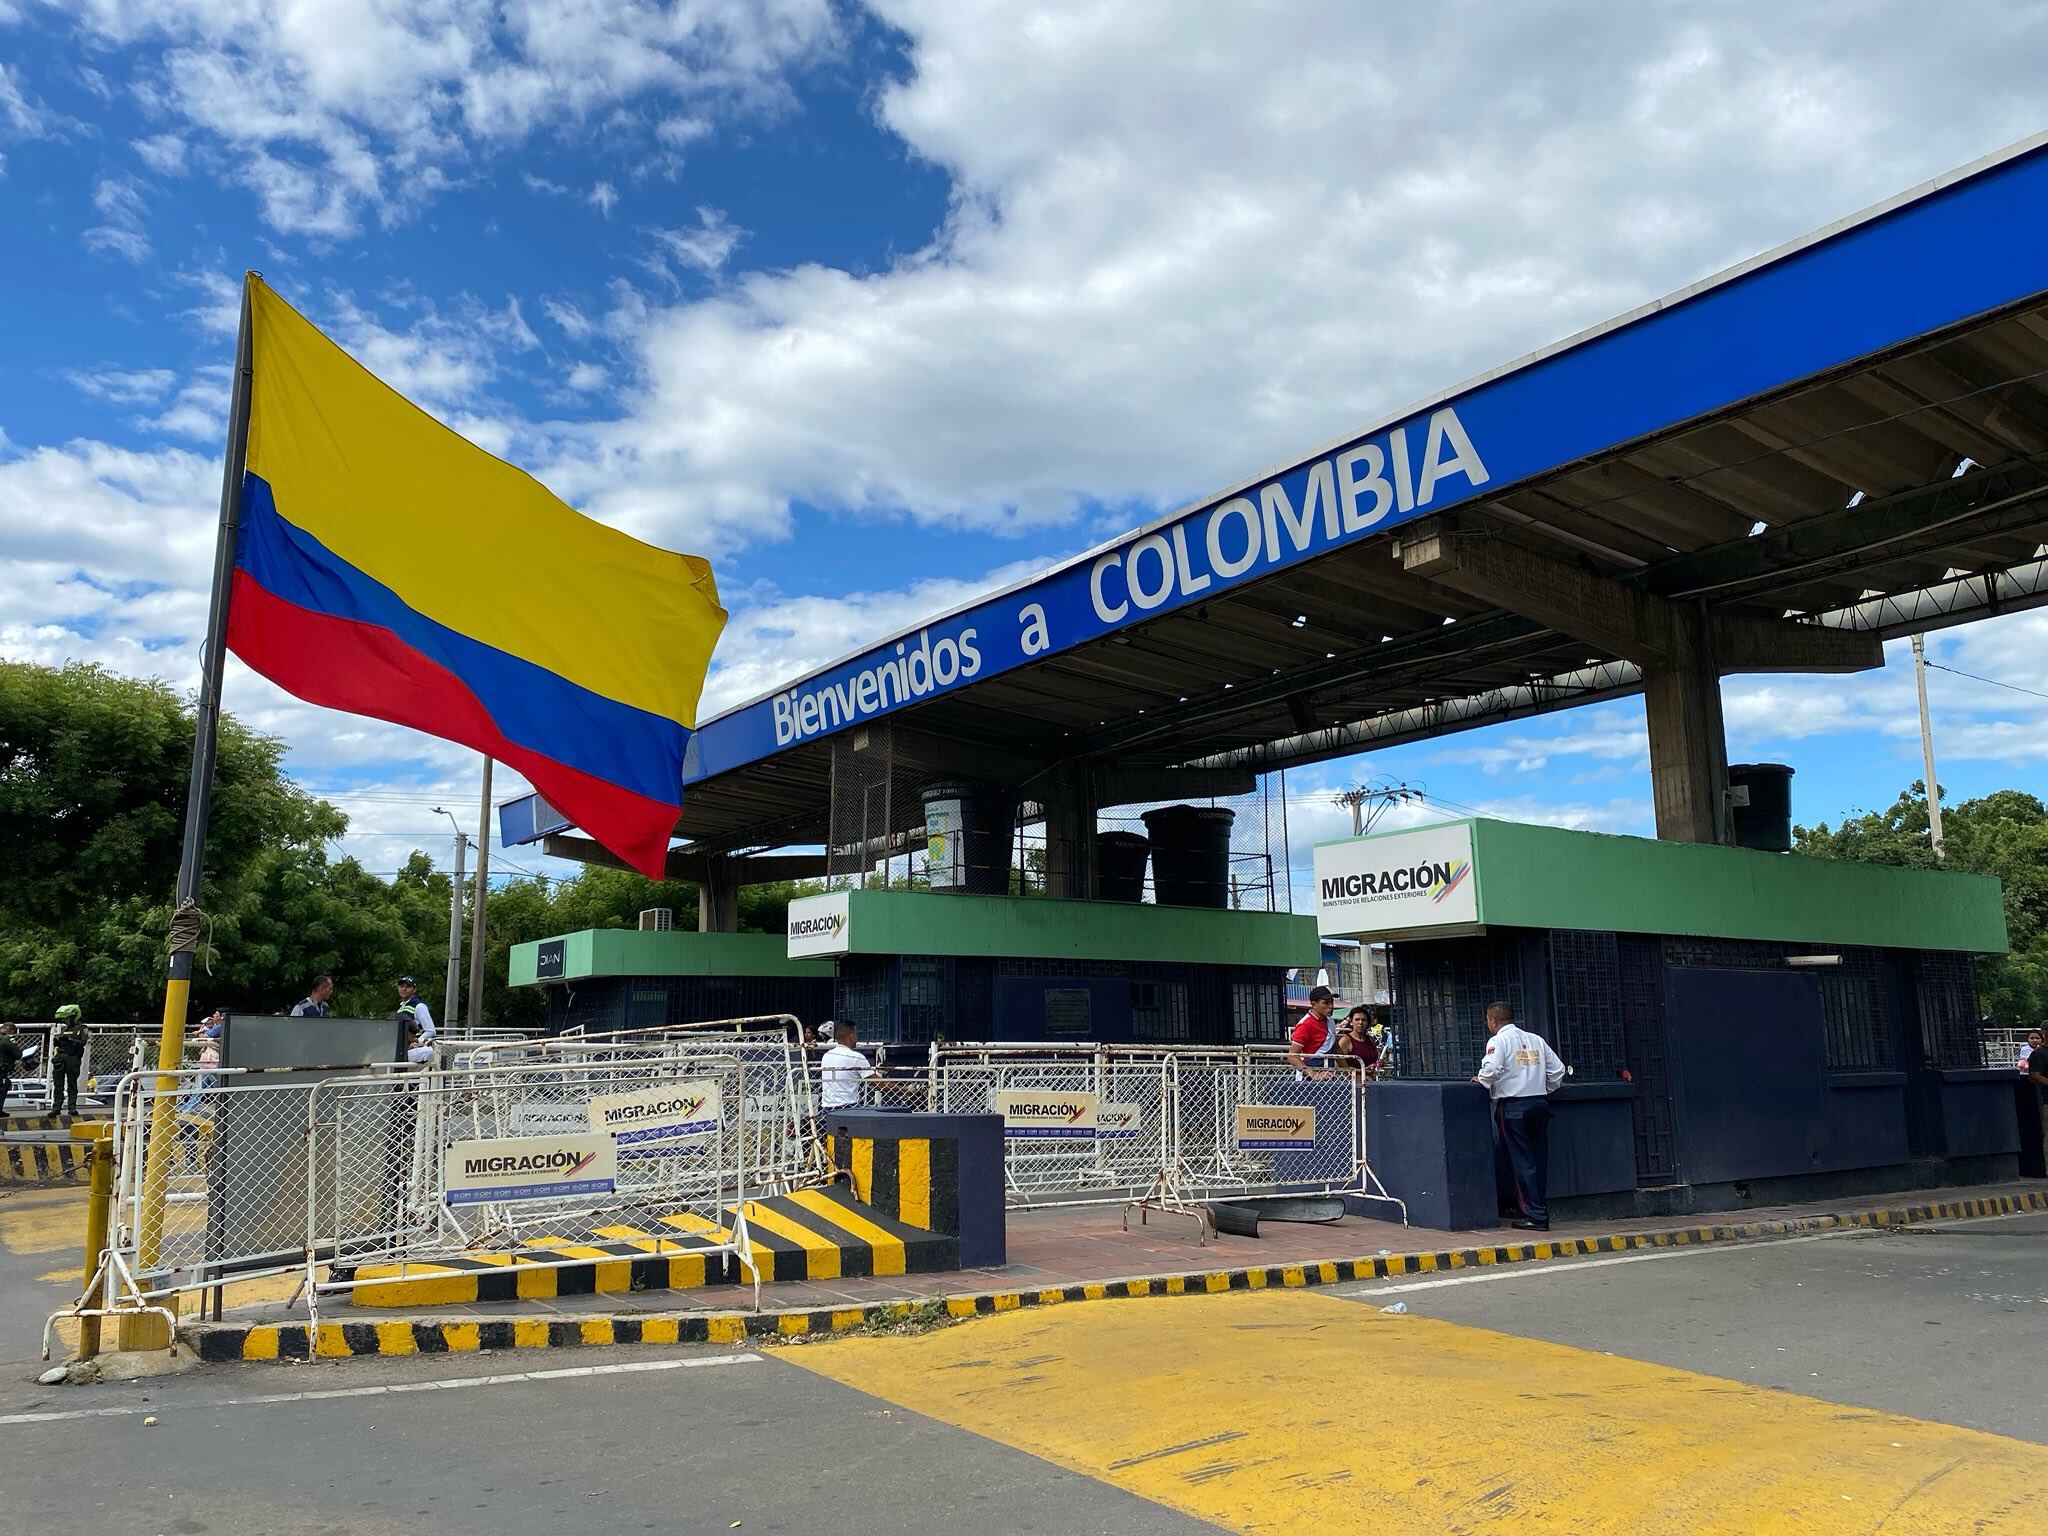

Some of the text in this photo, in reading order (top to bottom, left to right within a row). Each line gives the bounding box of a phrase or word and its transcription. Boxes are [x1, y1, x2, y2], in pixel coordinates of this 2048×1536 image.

[772, 406, 1490, 747] Bienvenidos a COLOMBIA
[1322, 860, 1451, 900] MIGRACIÓN
[1322, 898, 1352, 907] MINISTERIO
[1361, 894, 1394, 904] RELACIONES
[1394, 889, 1428, 900] EXTERIORES
[790, 912, 840, 936] MIGRACIÓN
[1009, 1102, 1077, 1116] MIGRACIÓN
[1246, 1115, 1299, 1129] MIGRACIÓN
[465, 1149, 581, 1174] MIGRACIÓN
